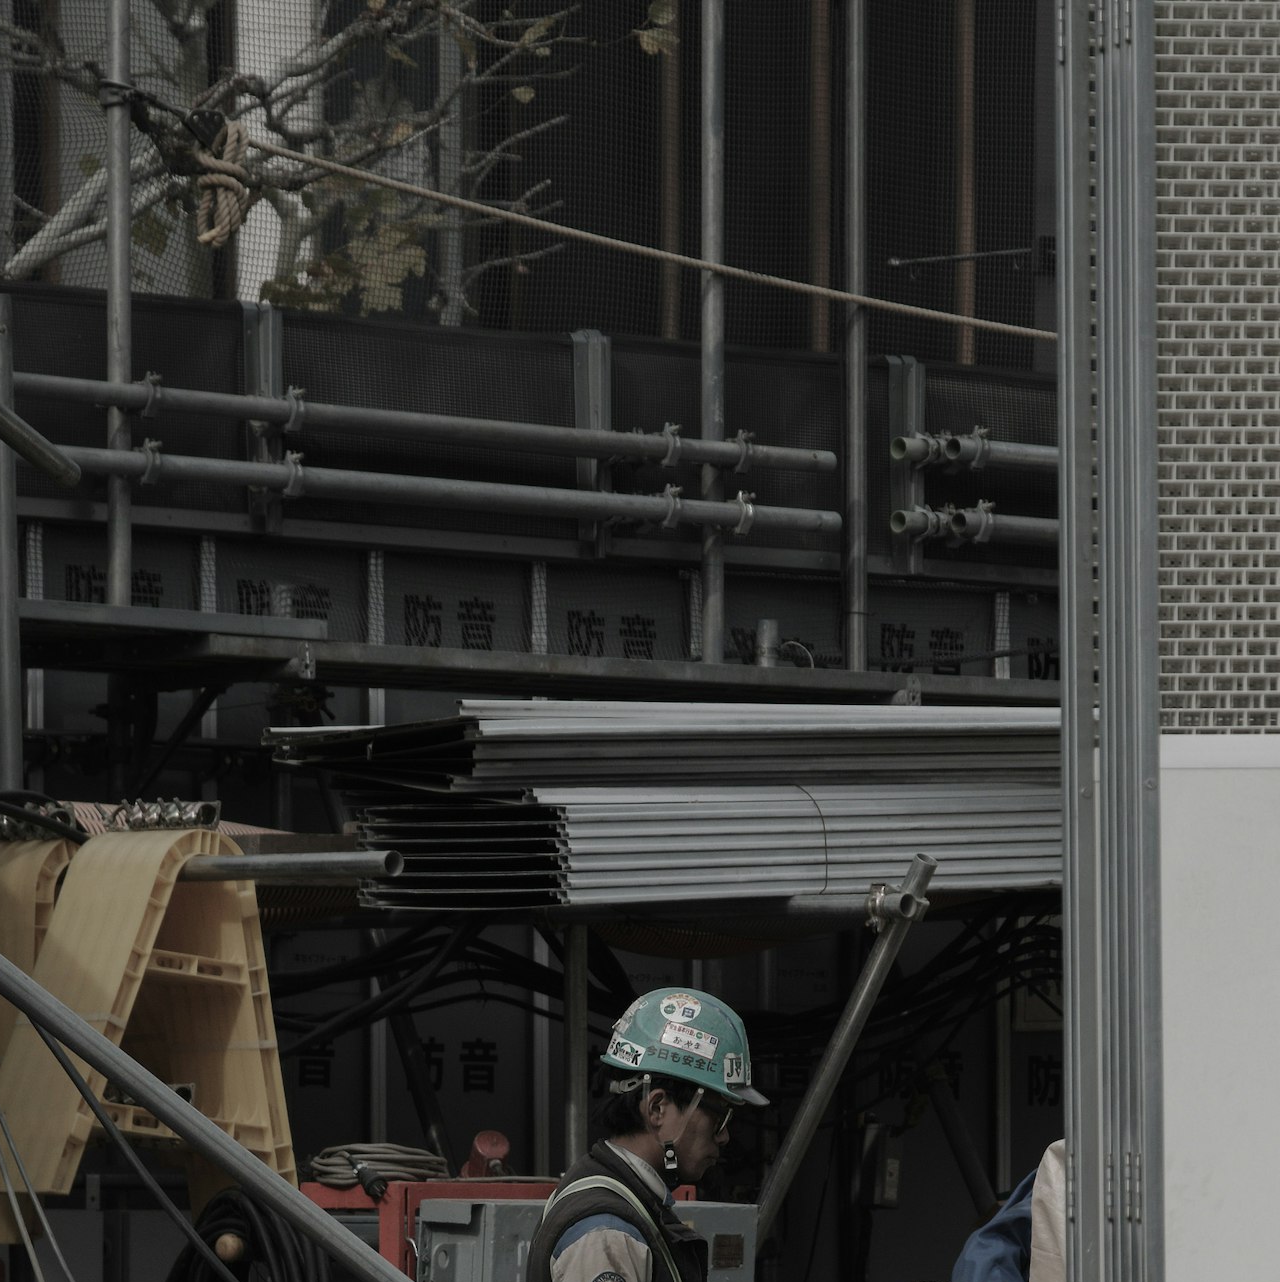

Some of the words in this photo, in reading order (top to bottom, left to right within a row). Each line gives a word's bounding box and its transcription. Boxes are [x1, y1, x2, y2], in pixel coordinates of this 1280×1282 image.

[404, 594, 496, 649] 防音
[567, 608, 657, 659] 防音
[880, 623, 965, 675] 防音
[646, 1045, 718, 1072] 今日も安全に
